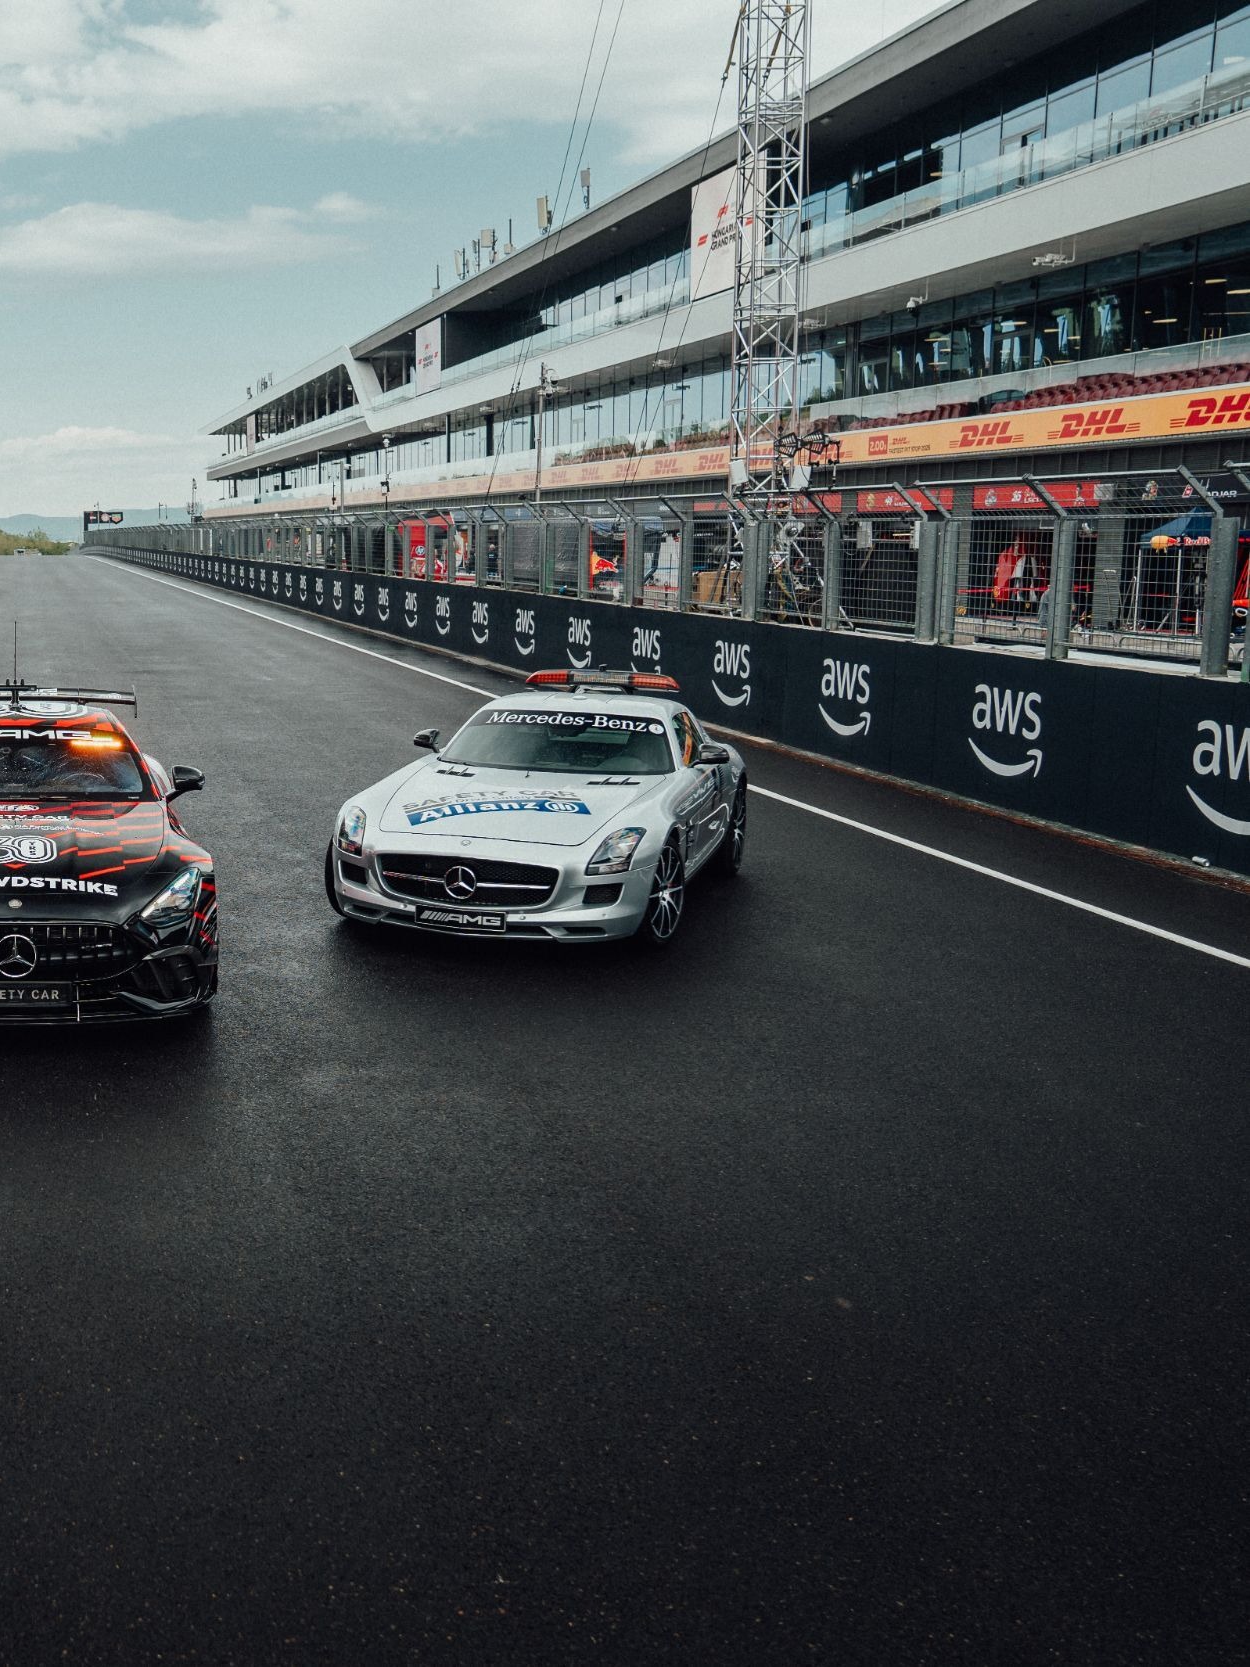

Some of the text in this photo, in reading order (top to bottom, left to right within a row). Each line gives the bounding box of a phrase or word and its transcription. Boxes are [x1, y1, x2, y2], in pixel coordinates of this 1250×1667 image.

[1059, 408, 1126, 438] DHL
[1184, 393, 1250, 427] DH
[959, 421, 1013, 447] DHL
[654, 458, 678, 474] DHL
[699, 452, 728, 470] DHL
[378, 587, 389, 606] aws
[404, 591, 418, 612] aws
[436, 595, 450, 618] aws
[472, 600, 488, 626] aws
[515, 608, 535, 635] aws
[567, 616, 591, 646] aws
[632, 626, 661, 661] aws
[713, 638, 750, 678] aws
[821, 656, 870, 705] aws
[486, 711, 649, 733] Mercedes-Benz
[972, 683, 1041, 741] aws
[1193, 720, 1250, 782] aw
[402, 790, 578, 810] SAFETY CAR
[419, 800, 540, 822] Allianz
[449, 913, 502, 927] AMG
[31, 988, 60, 1000] CAR
